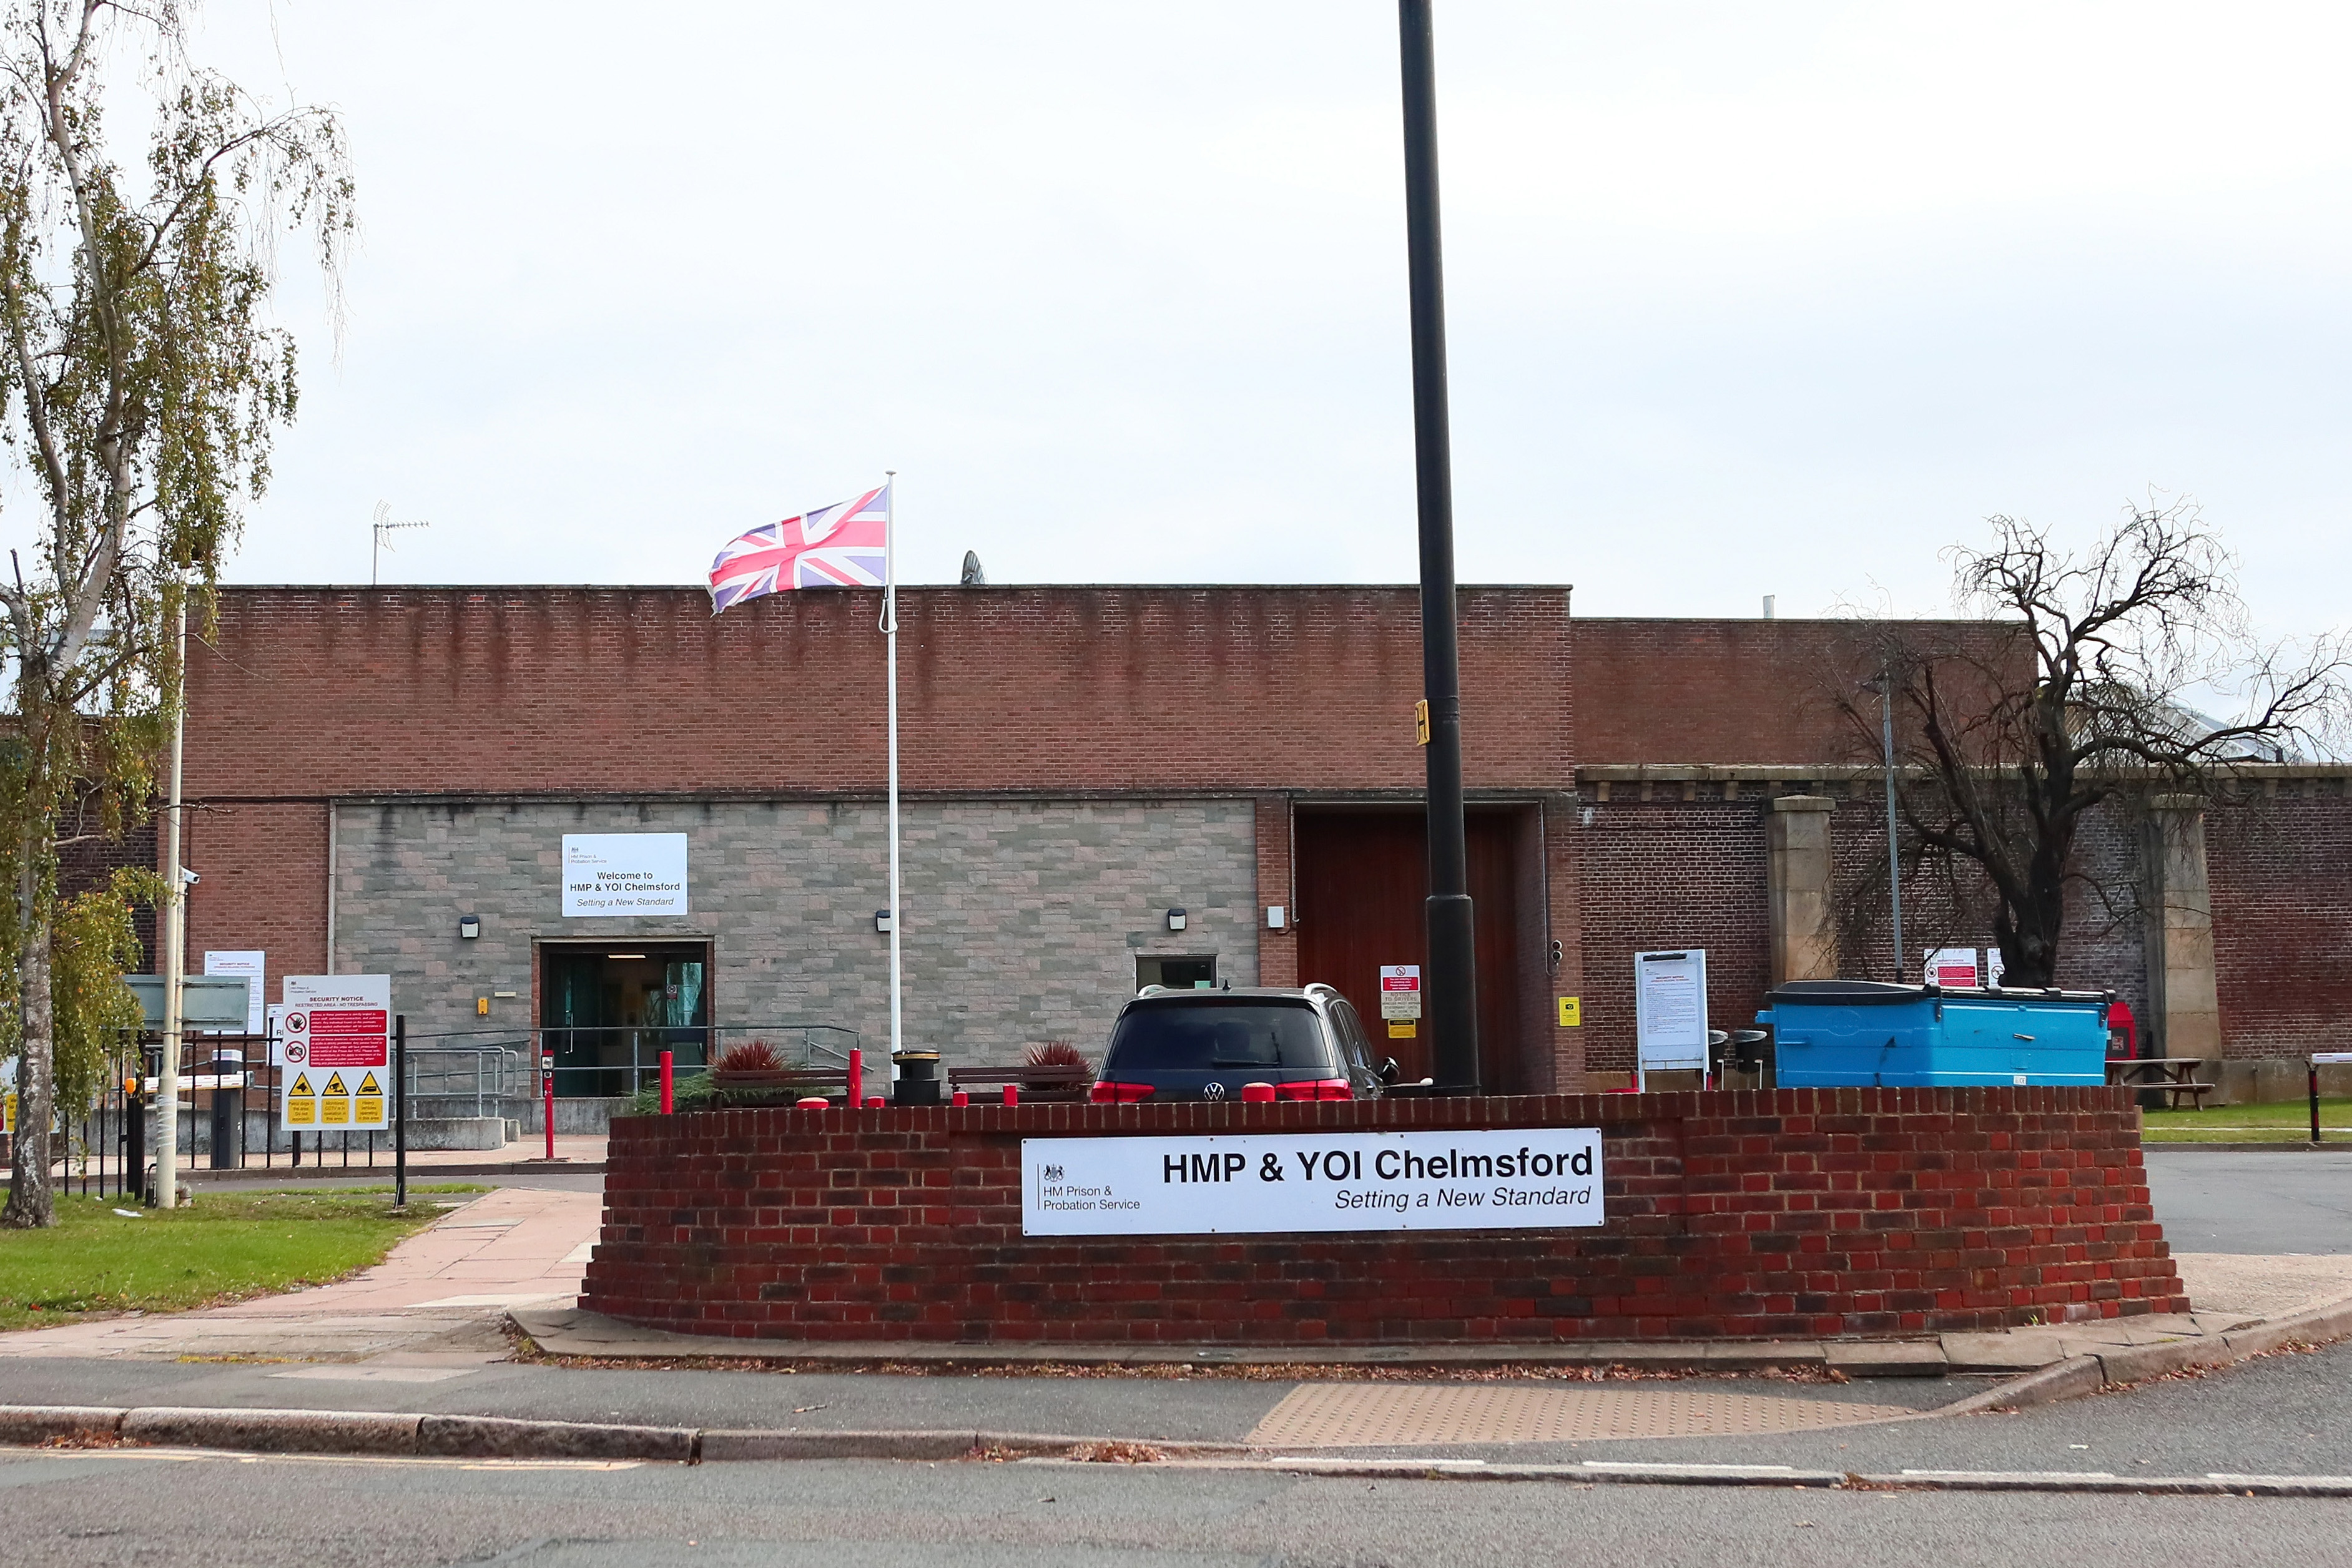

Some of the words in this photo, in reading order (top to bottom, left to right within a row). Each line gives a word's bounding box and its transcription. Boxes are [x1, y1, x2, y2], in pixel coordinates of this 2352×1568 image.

[624, 883, 680, 891] Chelmsford
[577, 899, 605, 908] Setting
[636, 898, 674, 906] Standard
[1164, 1153, 1246, 1183] HMP
[1259, 1153, 1285, 1182] &
[1296, 1151, 1361, 1180] YOI
[1375, 1145, 1592, 1180] Chelmsford
[1044, 1186, 1063, 1196] HM
[1066, 1186, 1101, 1196] Prison
[1104, 1185, 1112, 1196] &
[1044, 1200, 1096, 1210] Probation
[1100, 1199, 1140, 1209] Service
[1335, 1190, 1409, 1212] Setting
[1416, 1193, 1429, 1207] a
[1437, 1188, 1485, 1206] New
[1492, 1186, 1592, 1206] Standard
